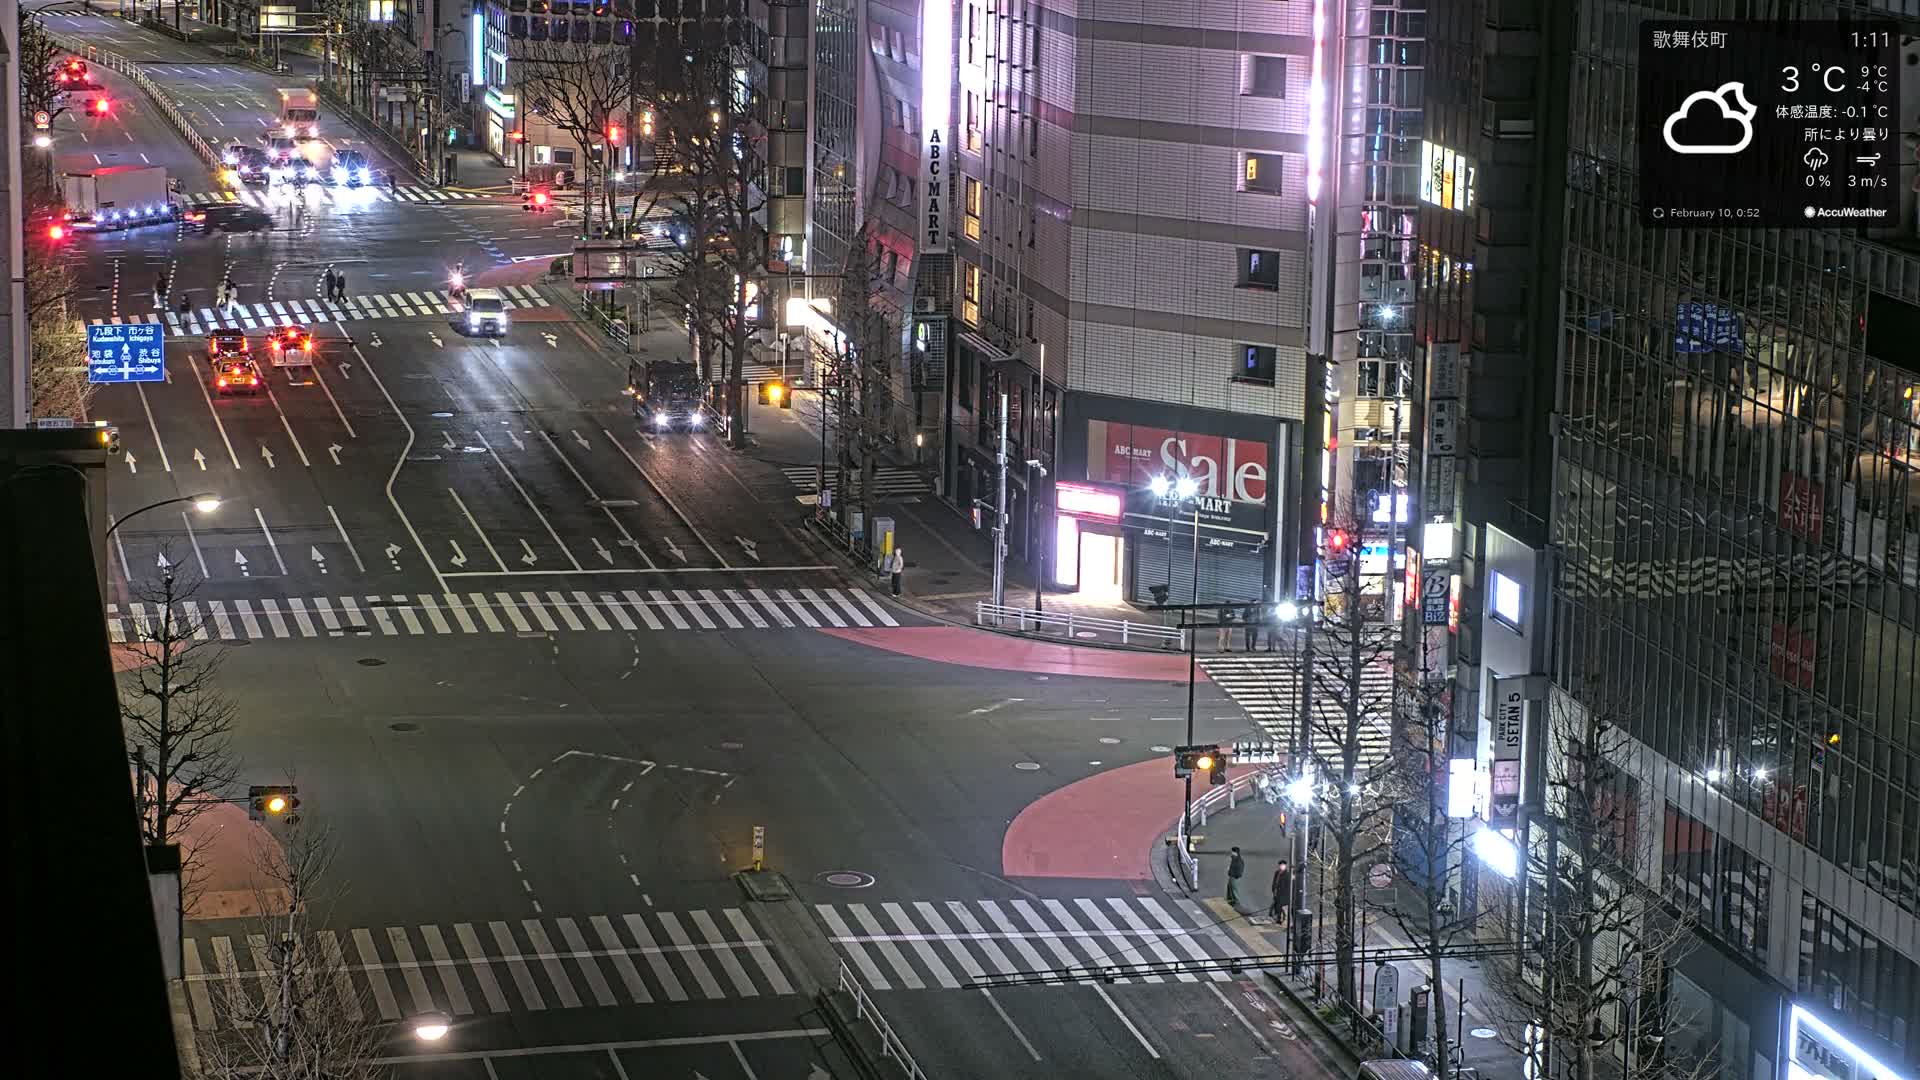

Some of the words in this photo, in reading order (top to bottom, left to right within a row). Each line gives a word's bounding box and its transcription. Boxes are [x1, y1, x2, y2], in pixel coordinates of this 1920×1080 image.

[95, 327, 122, 336] 九段下
[139, 349, 160, 357] 渋谷
[1160, 437, 1267, 505] Sale
[1509, 692, 1521, 703] 5
[1498, 703, 1507, 719] CITY
[1498, 720, 1506, 741] PARK
[1507, 707, 1521, 747] ISETAN
